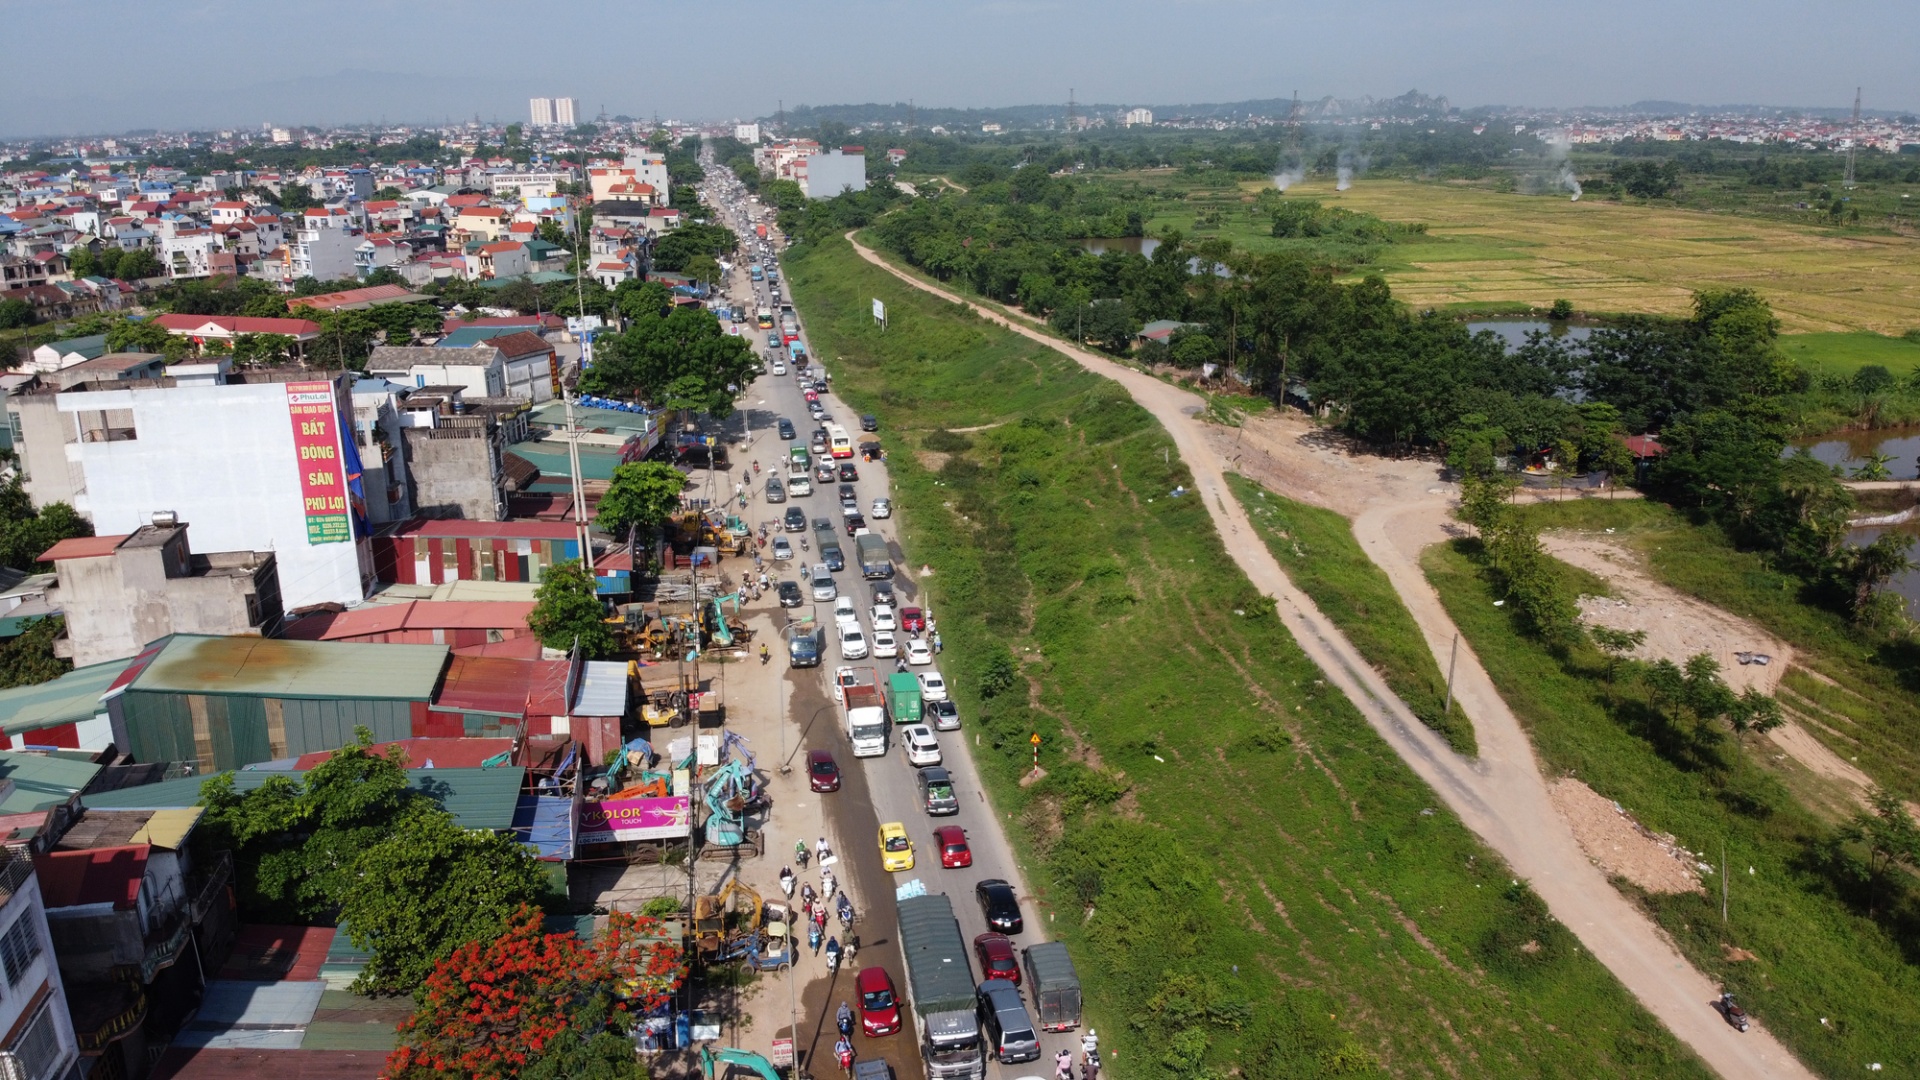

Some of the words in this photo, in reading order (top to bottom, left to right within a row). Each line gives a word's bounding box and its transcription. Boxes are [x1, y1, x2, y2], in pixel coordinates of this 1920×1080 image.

[301, 417, 325, 435] BẤT
[300, 443, 335, 462] ĐỘNG
[582, 807, 641, 821] YKOLOR
